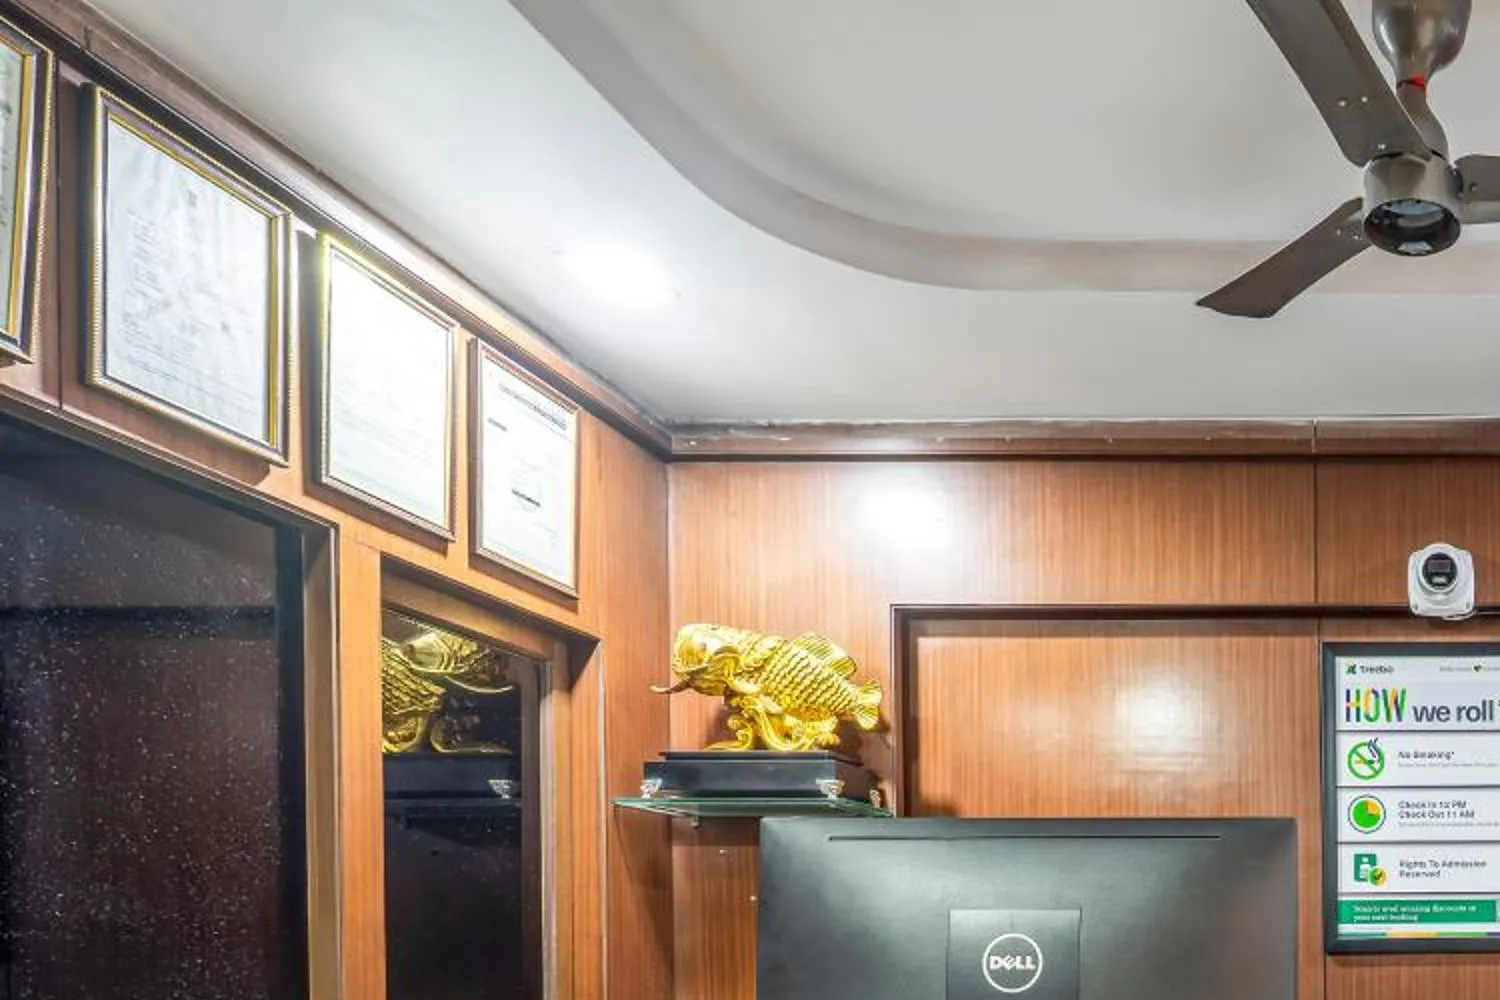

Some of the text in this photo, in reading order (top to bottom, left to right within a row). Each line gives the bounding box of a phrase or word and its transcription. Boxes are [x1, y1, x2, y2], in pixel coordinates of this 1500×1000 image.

[1345, 688, 1408, 723] HOW
[1412, 705, 1451, 723] we
[990, 955, 1036, 971] DELL
